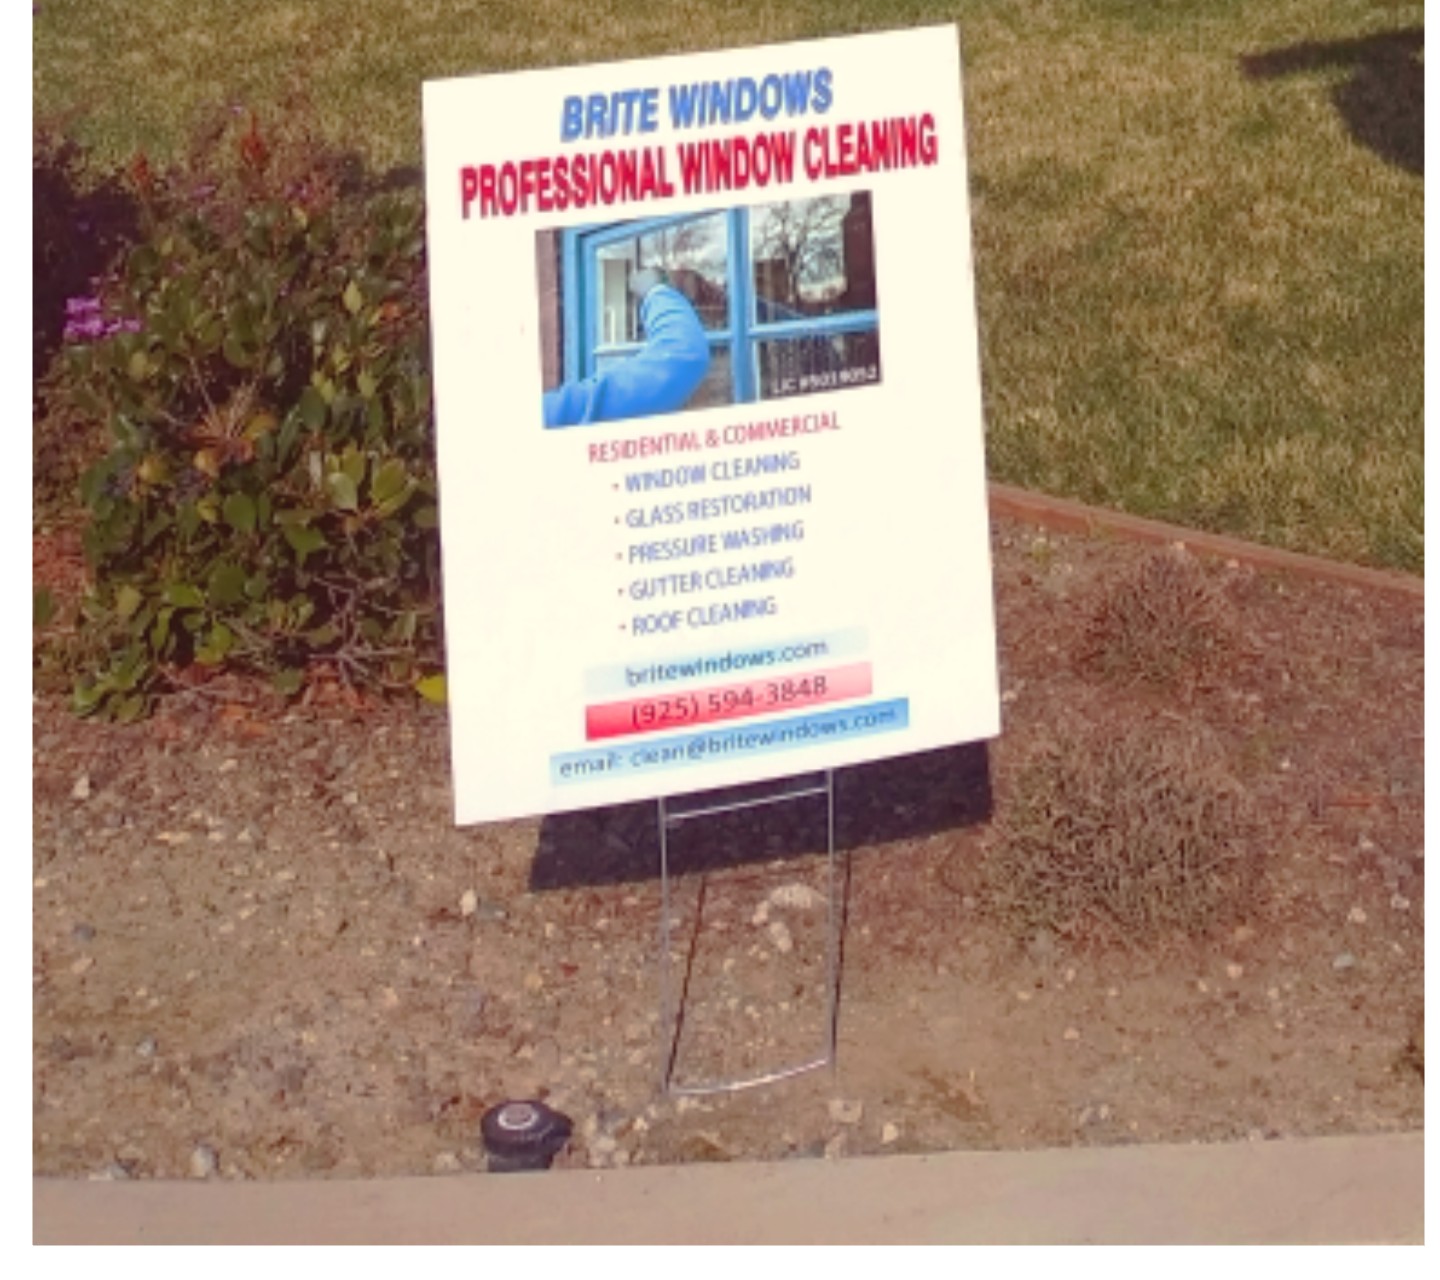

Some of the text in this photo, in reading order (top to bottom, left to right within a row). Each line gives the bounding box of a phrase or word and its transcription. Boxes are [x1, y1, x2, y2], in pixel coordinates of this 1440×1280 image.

[560, 67, 834, 142] BRITE WINDOWS
[460, 112, 939, 220] PROFESSIONAL WINDOW CLEANING
[587, 411, 841, 463] RESIDENTIAL & COMMERCIAL
[624, 450, 801, 493] WINDOW CLEANING
[625, 484, 812, 529] GLASS RESTORATION
[628, 520, 804, 565] PRESSURE WASHING
[629, 556, 795, 601] GUTTER CLEANING
[632, 595, 778, 637] ROOF CLEANING
[625, 639, 829, 687] britewindows.com
[631, 675, 828, 730] (925) 594-3848
[559, 708, 897, 778] email: clean@britewindows.com
